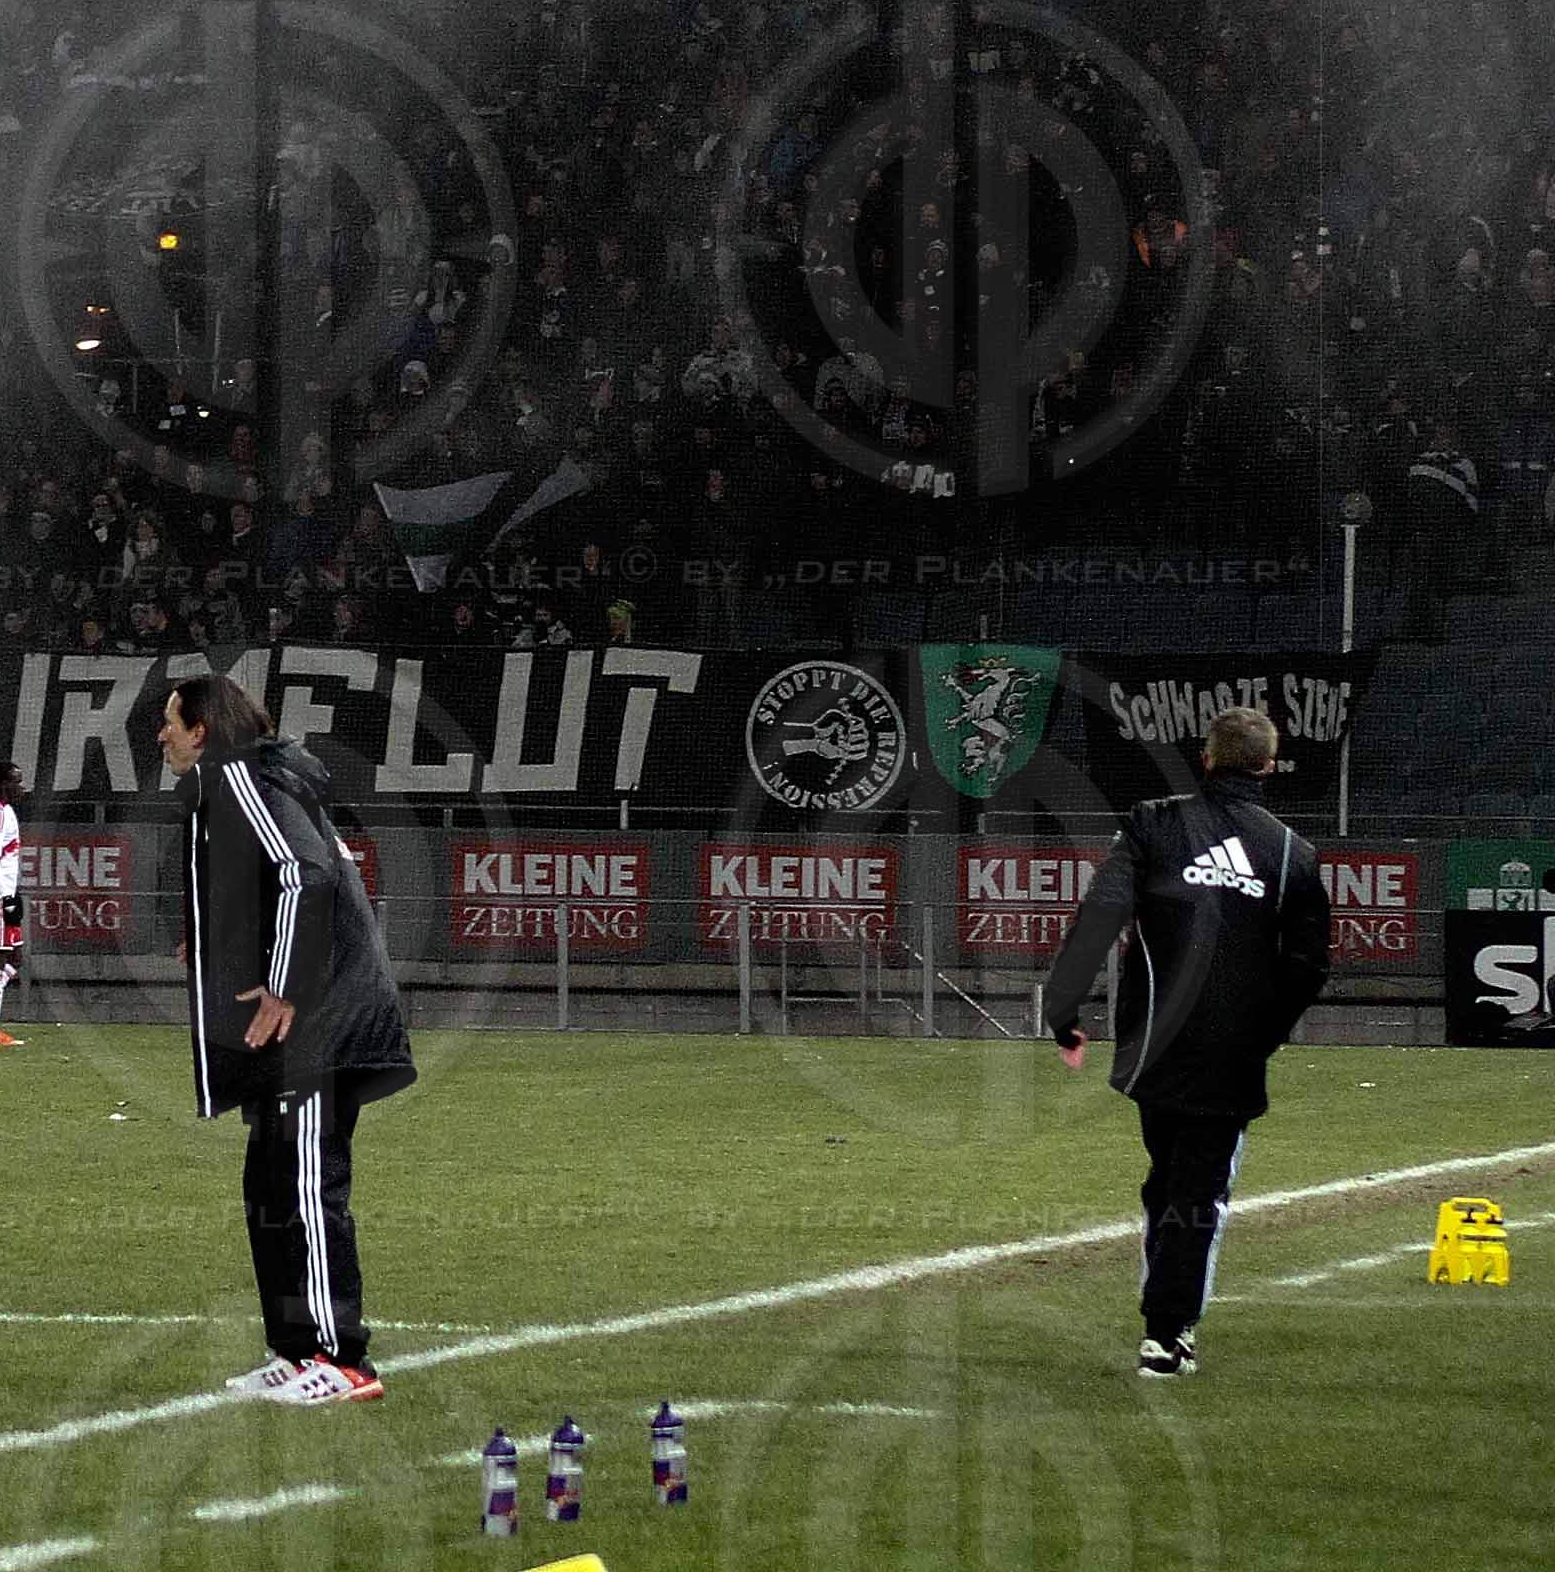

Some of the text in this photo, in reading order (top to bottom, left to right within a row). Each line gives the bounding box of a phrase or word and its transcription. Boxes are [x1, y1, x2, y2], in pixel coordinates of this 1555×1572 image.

[756, 669, 892, 725] STOPPT DIE
[464, 853, 639, 896] KLEINE
[709, 856, 886, 900] KLEINE
[1182, 864, 1266, 899] adidas
[463, 907, 639, 939] ZEITUNG
